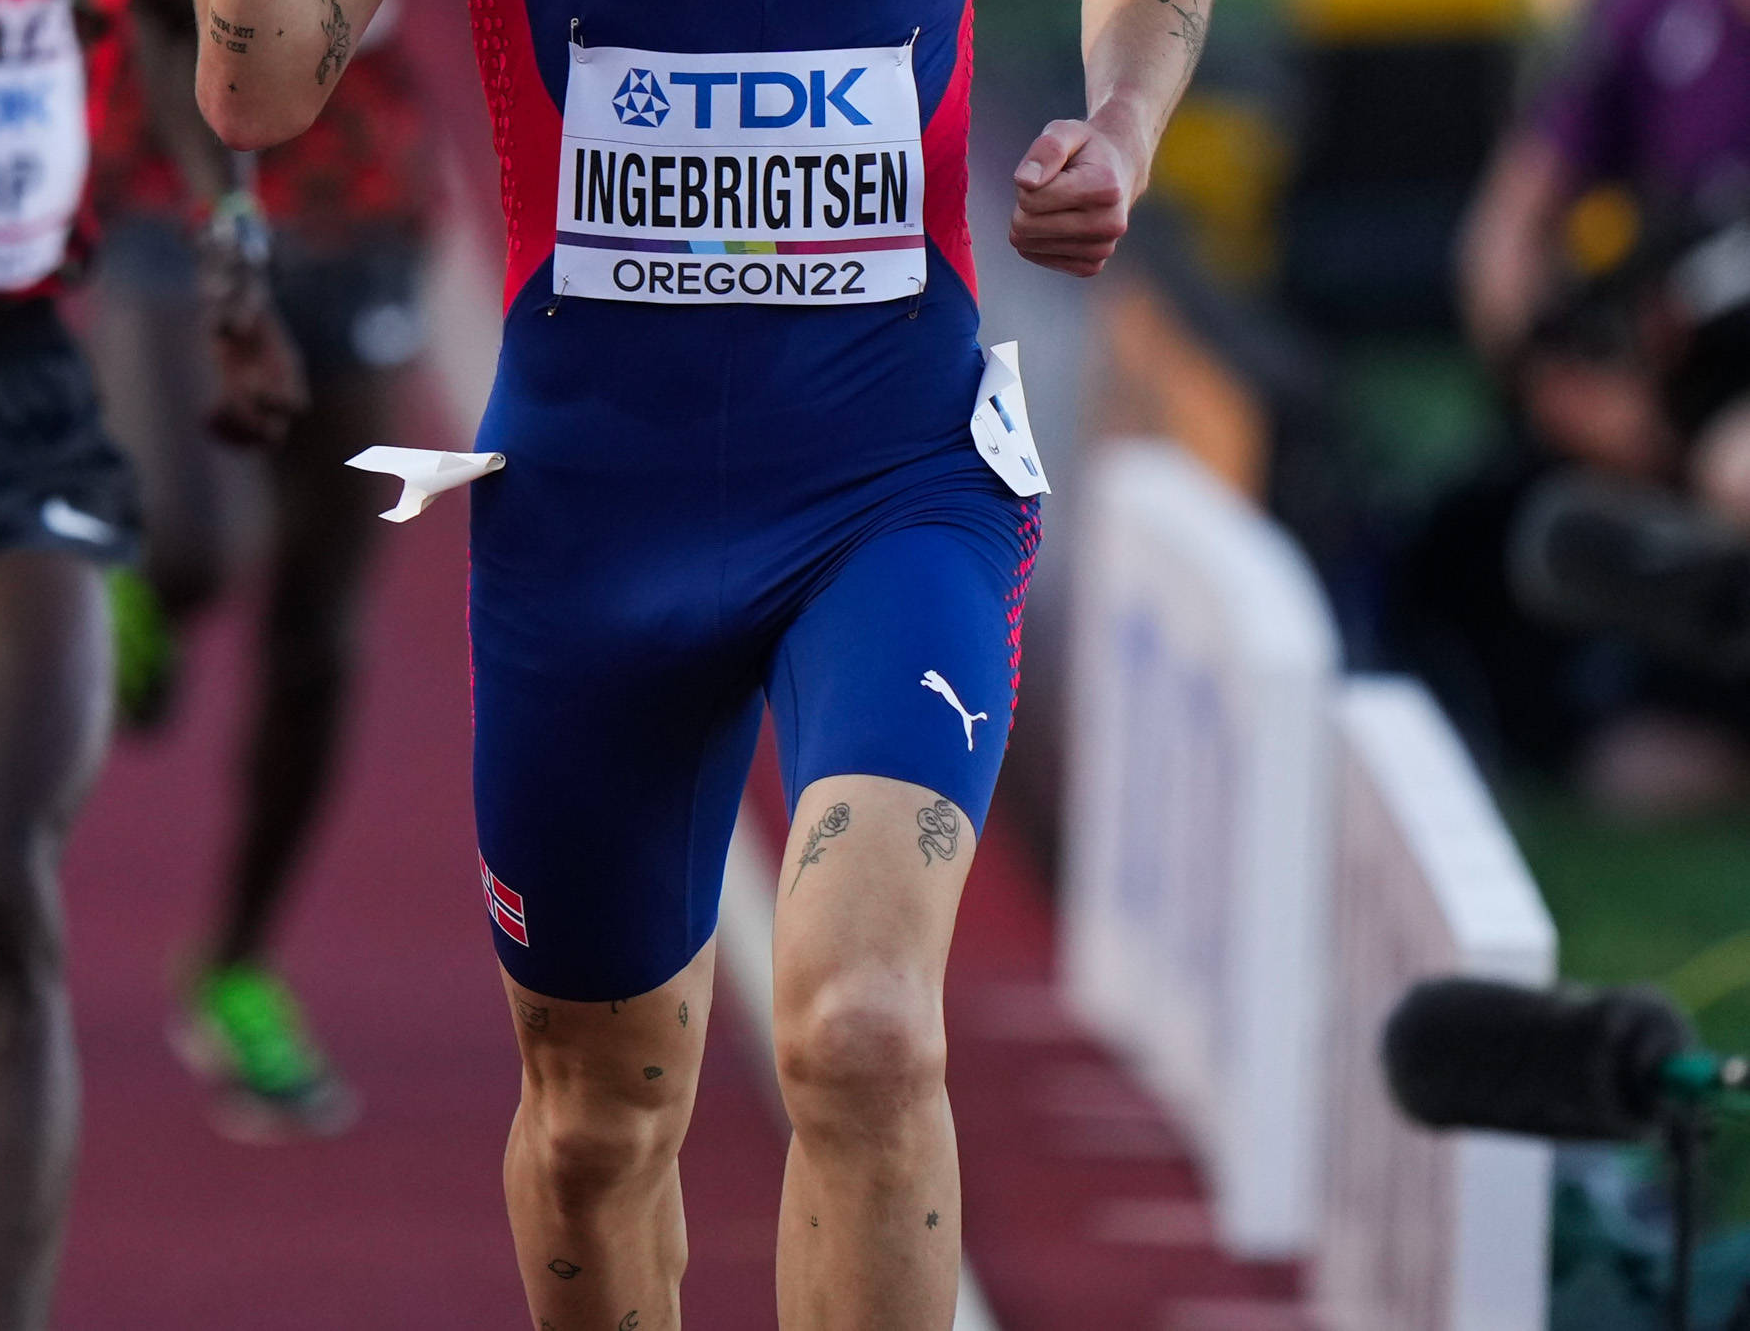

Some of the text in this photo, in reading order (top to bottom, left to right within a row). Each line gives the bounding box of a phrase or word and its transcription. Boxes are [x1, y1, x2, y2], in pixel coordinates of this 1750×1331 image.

[669, 67, 873, 129] TDK
[573, 148, 908, 229] INGEBRIGTSEN
[612, 258, 866, 296] OREGON22
